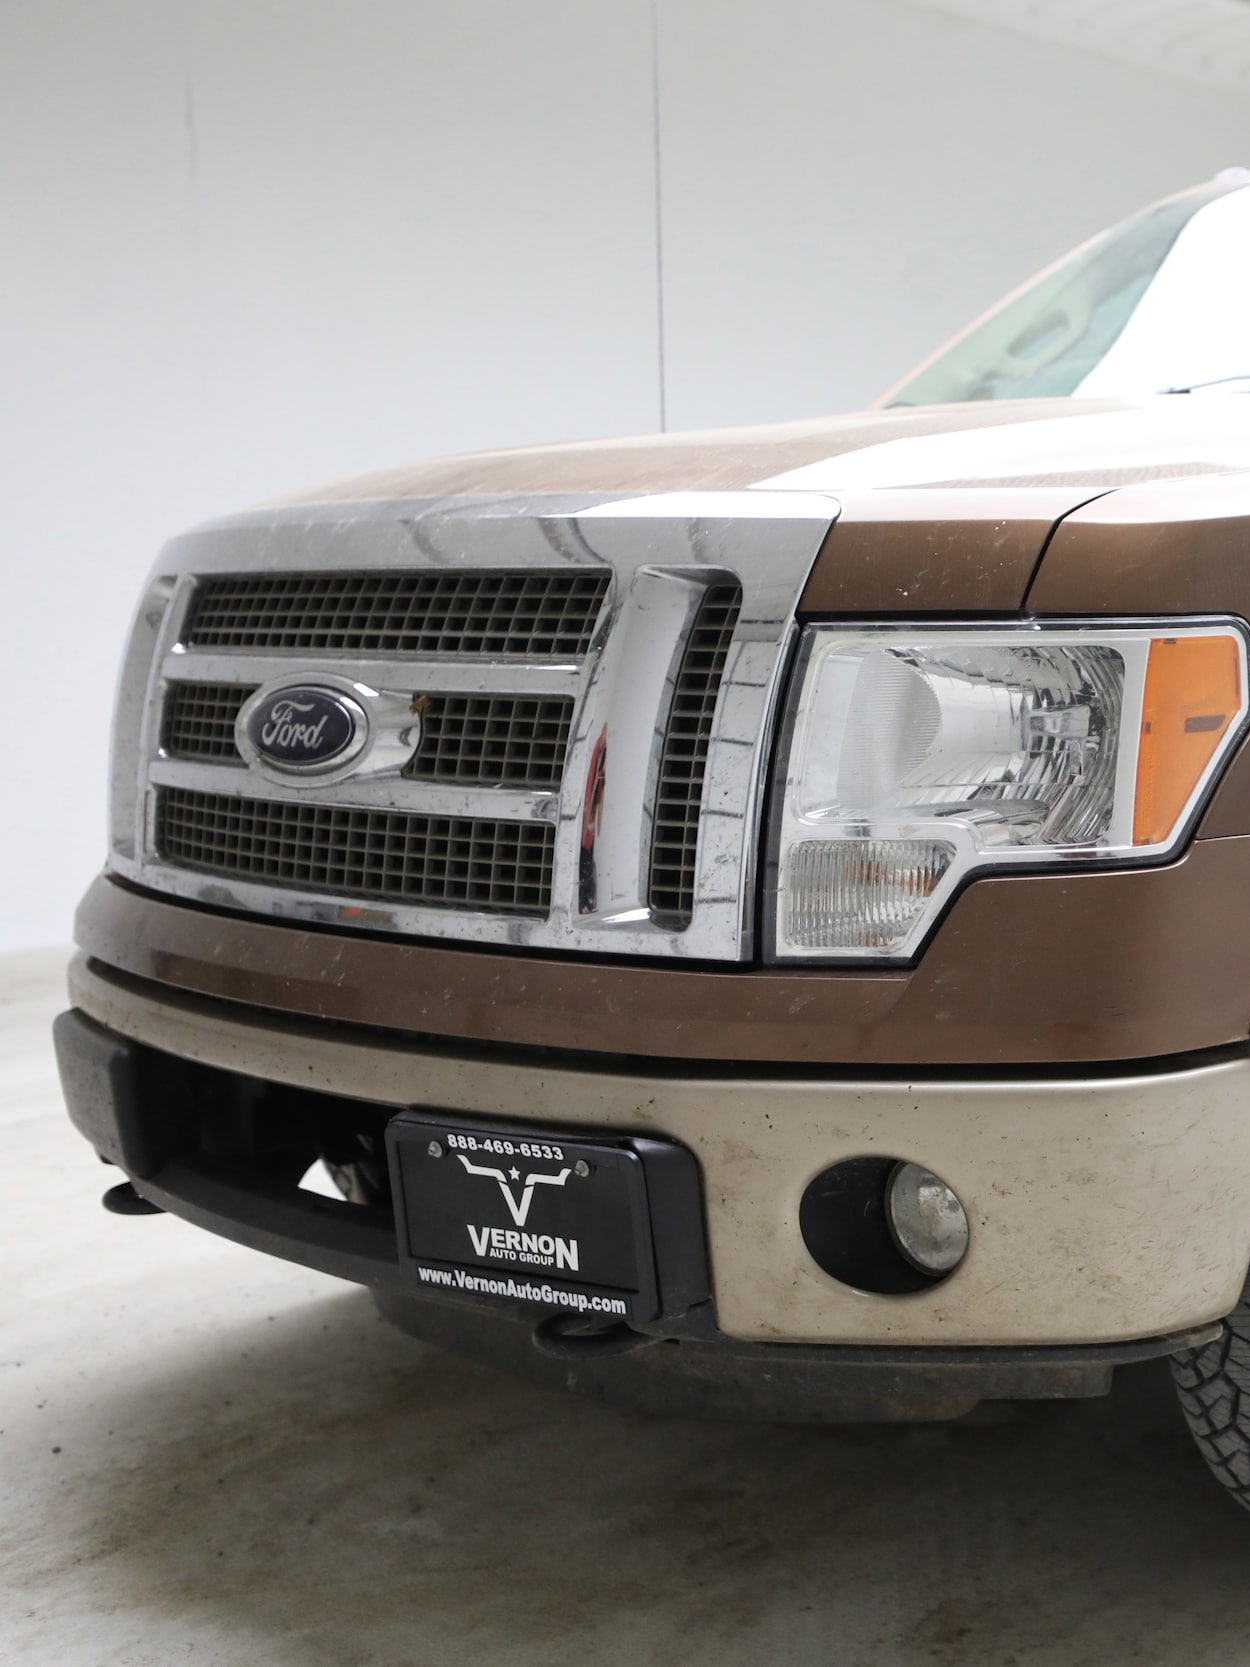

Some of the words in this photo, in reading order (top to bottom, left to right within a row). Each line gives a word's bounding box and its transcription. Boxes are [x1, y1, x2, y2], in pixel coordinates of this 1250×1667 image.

[261, 701, 329, 749] Ford
[447, 1134, 565, 1161] 888-469-6533
[466, 1224, 579, 1271] VERNON
[489, 1248, 517, 1261] AUTO
[518, 1251, 555, 1266] GROUP
[418, 1266, 627, 1314] www.VernonAutoGroup.com
